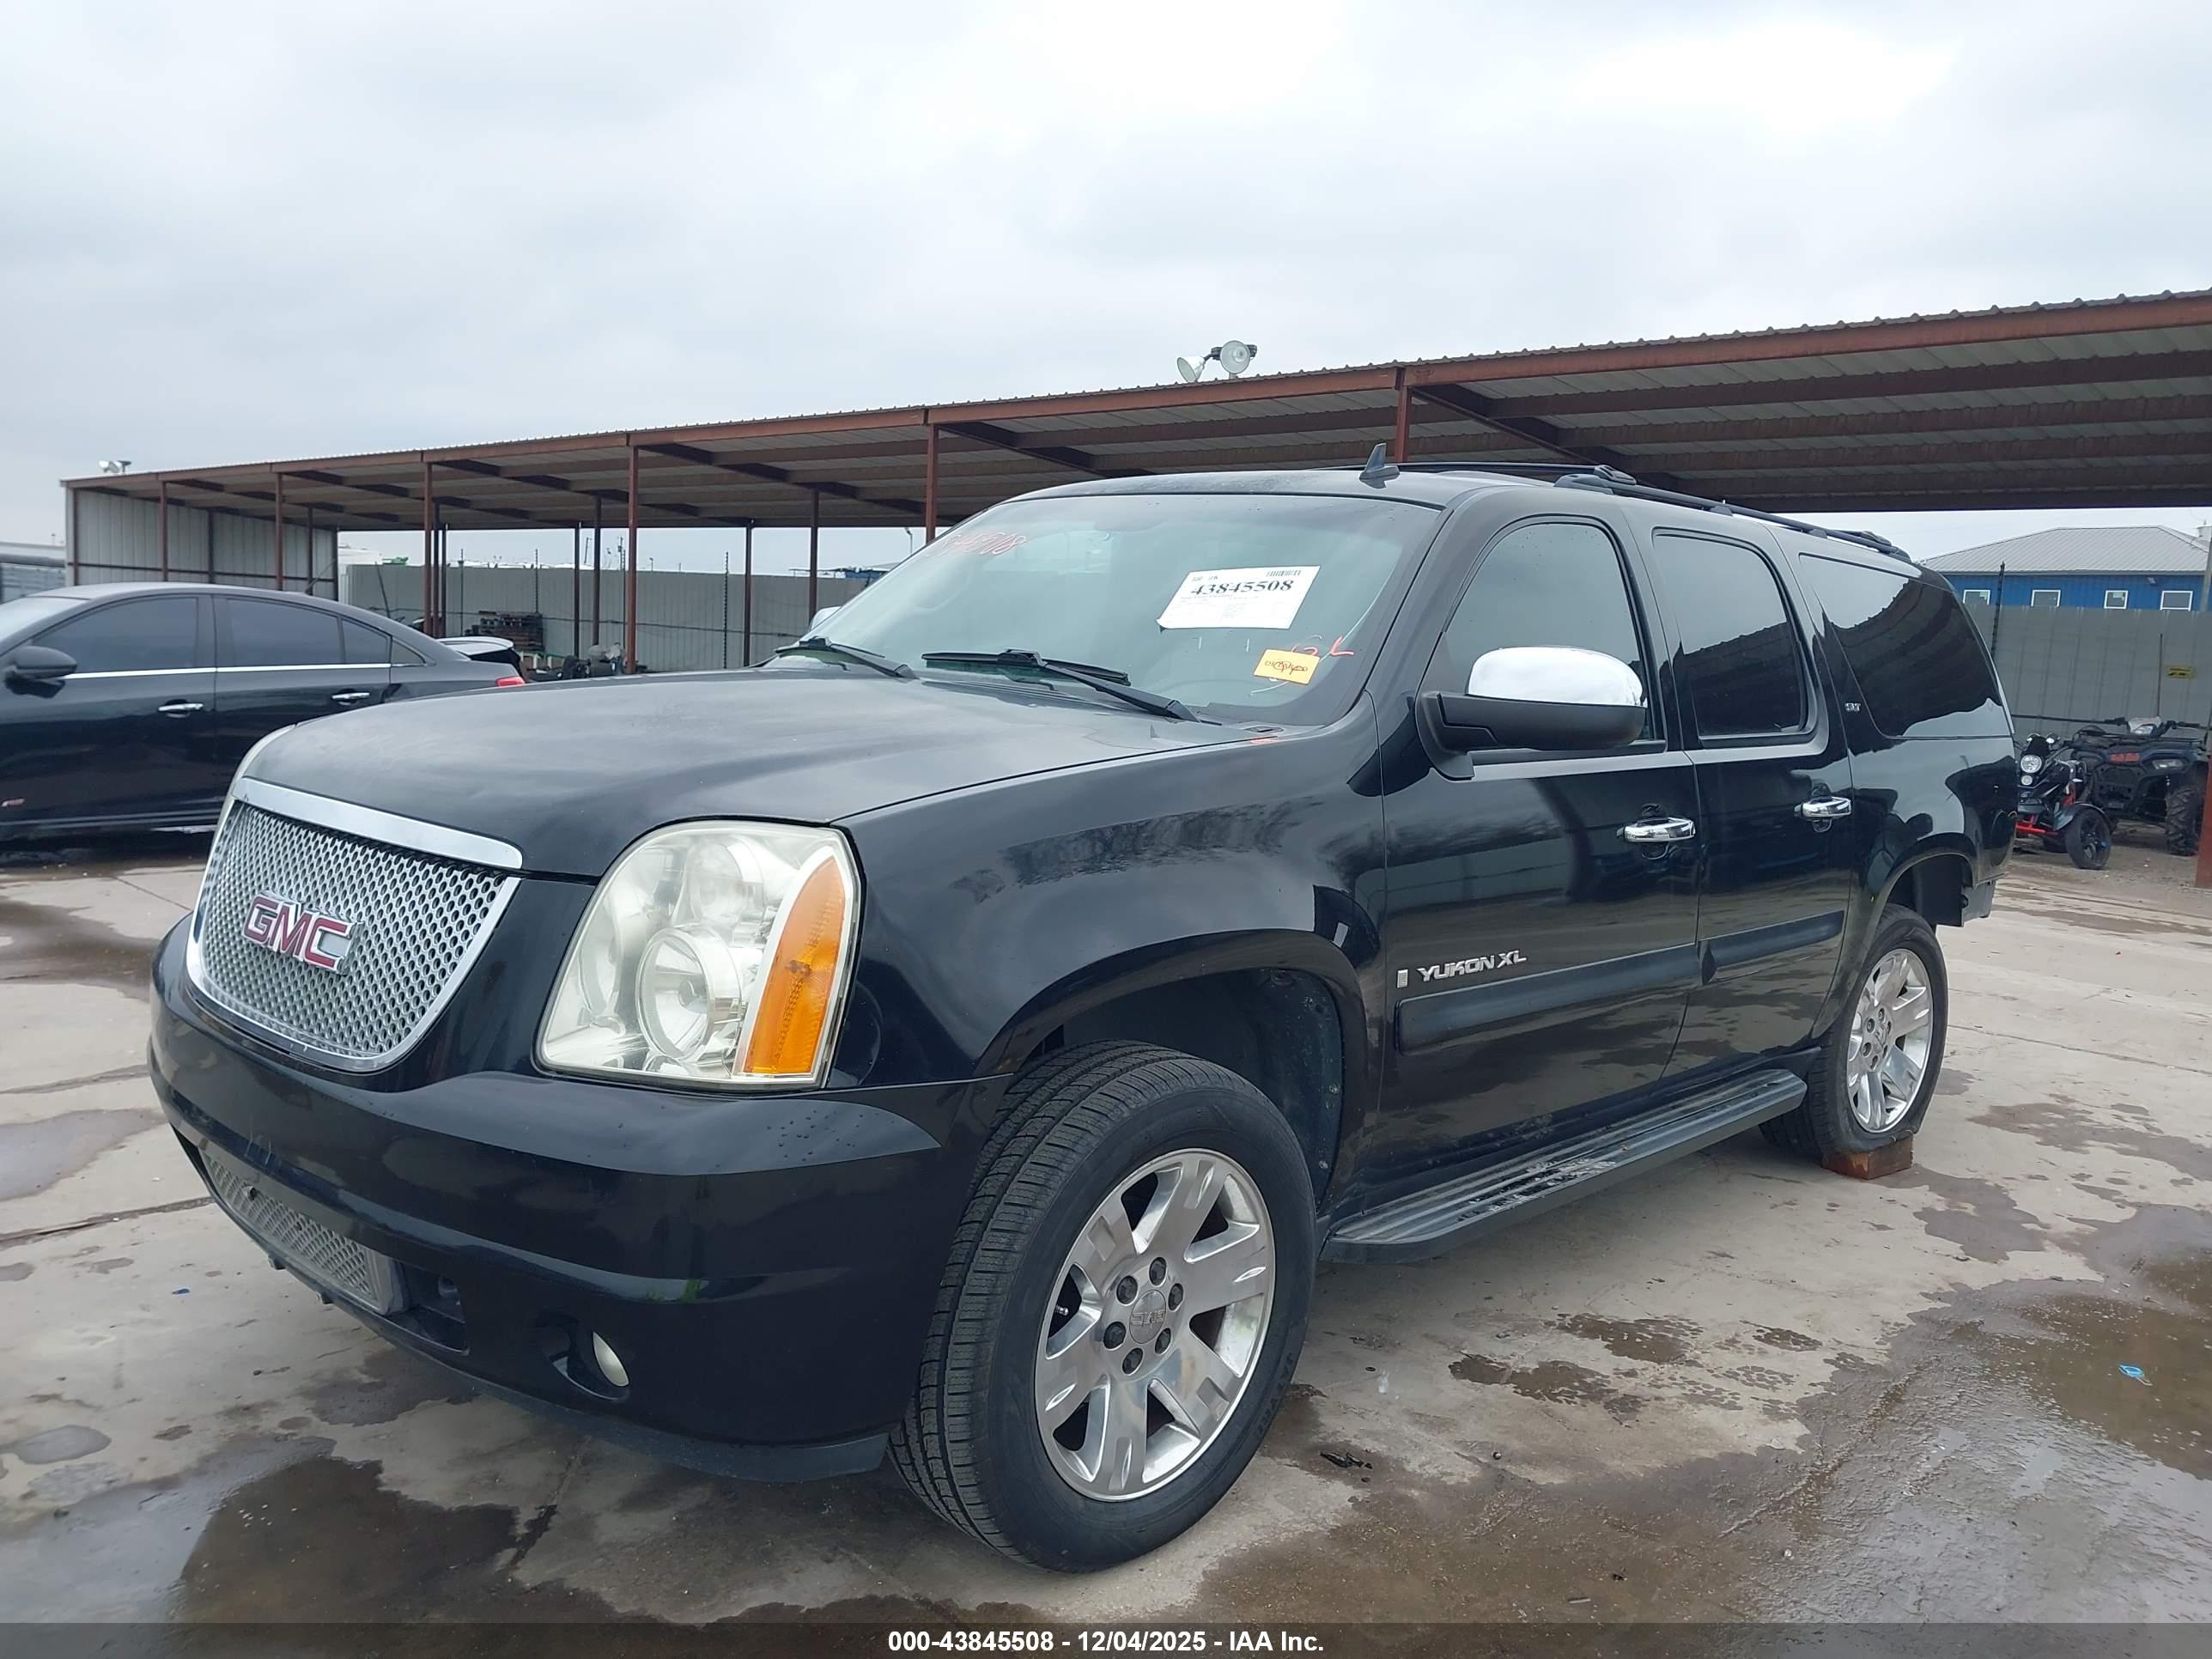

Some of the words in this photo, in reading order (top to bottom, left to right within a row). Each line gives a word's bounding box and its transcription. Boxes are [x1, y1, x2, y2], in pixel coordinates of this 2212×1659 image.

[1190, 580, 1294, 595] 43845508
[242, 894, 353, 972] GMC
[1416, 954, 1495, 982] YUKON
[1497, 950, 1528, 969] XL
